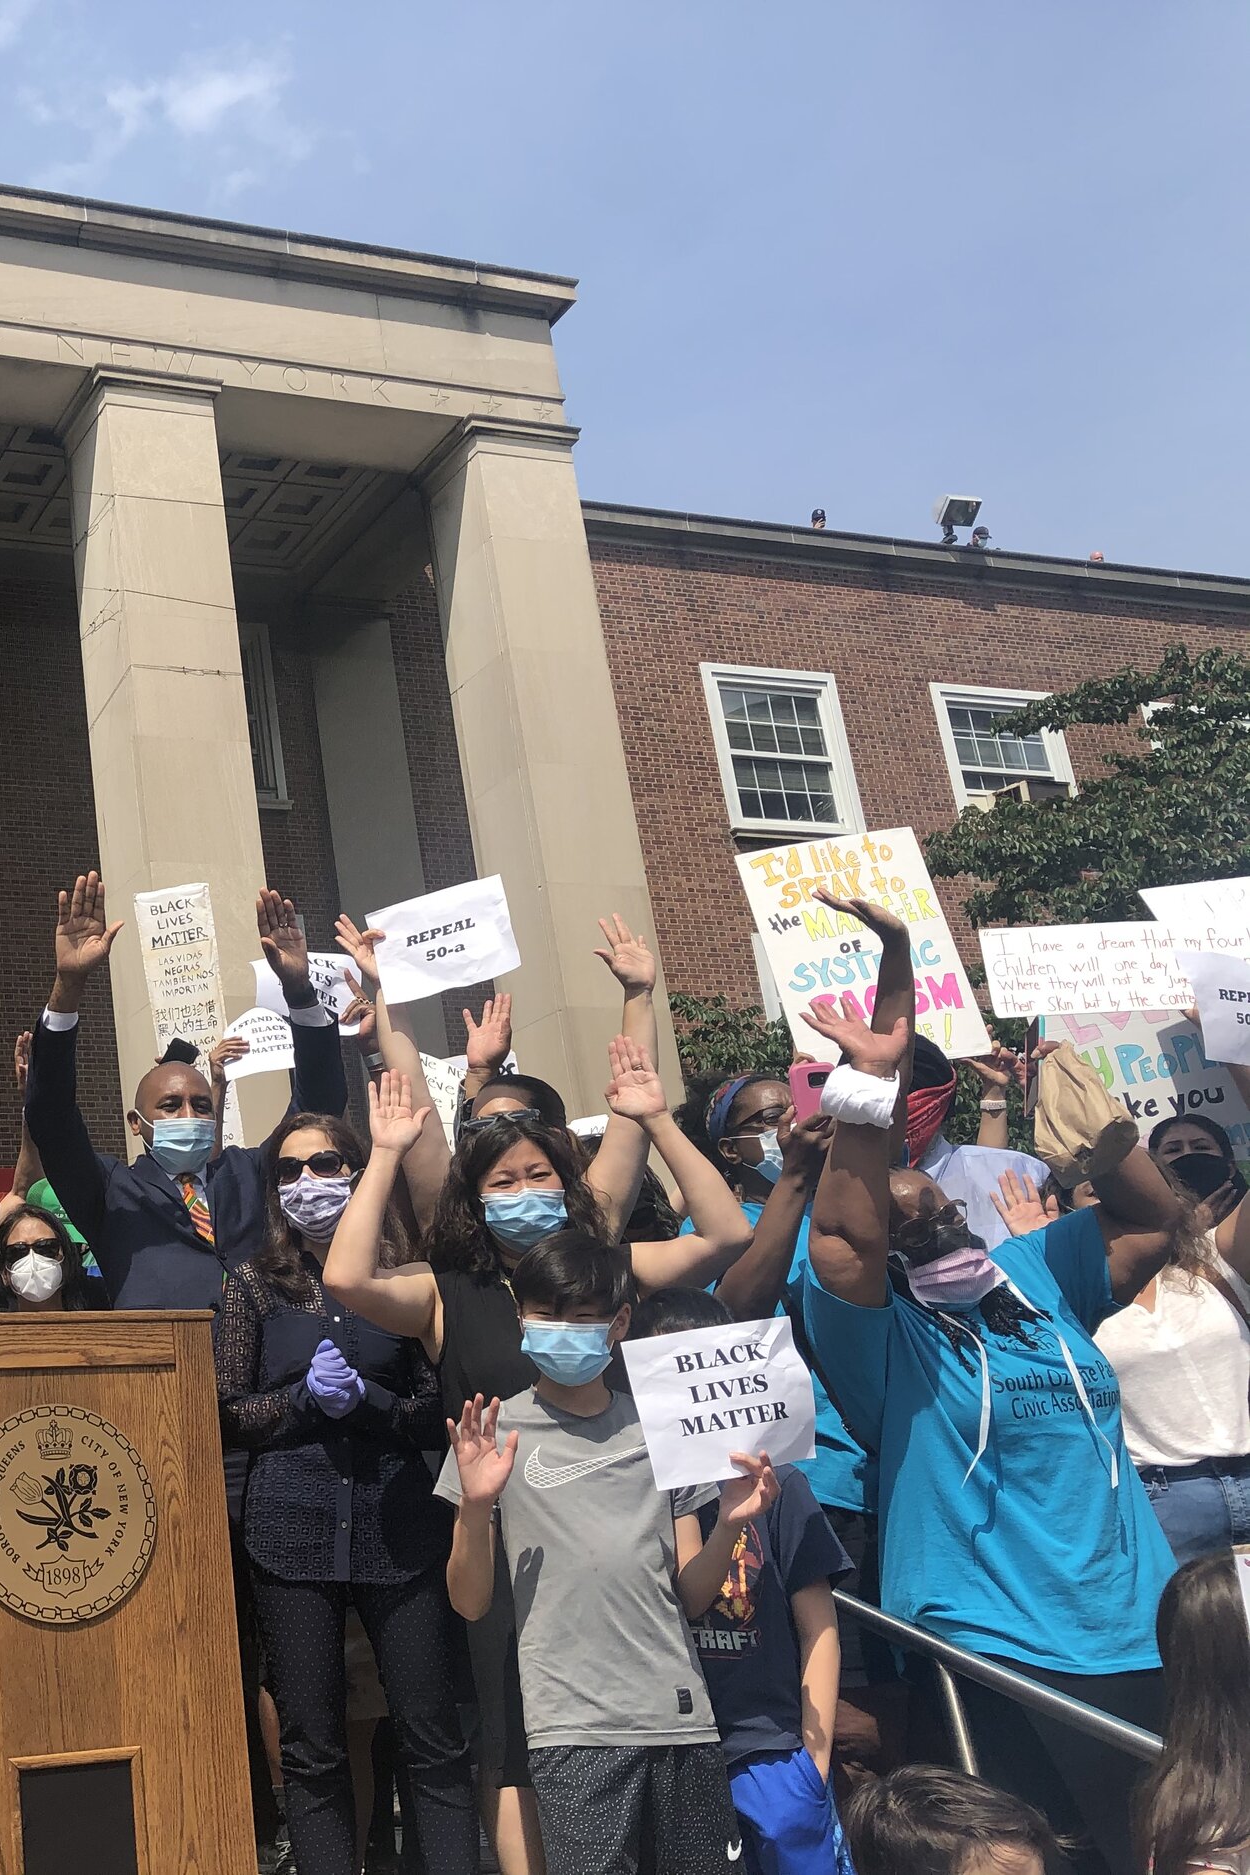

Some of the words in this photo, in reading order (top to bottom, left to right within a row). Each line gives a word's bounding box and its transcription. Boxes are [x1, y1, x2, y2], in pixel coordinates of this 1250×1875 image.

[55, 336, 198, 377] NEW
[236, 358, 392, 403] YORK
[749, 846, 804, 888] I'd
[809, 841, 862, 874] like
[861, 834, 894, 864] to
[870, 866, 906, 895] to
[150, 897, 196, 916] BLACK
[157, 912, 194, 930] LIVES
[406, 918, 476, 948] REPEAL
[767, 912, 802, 935] the
[151, 926, 209, 949] MATTER
[840, 939, 863, 955] OF
[1028, 931, 1065, 954] have
[1076, 942, 1086, 951] a
[1096, 931, 1136, 950] dream
[1140, 928, 1177, 949] that
[1184, 937, 1202, 951] my
[1206, 927, 1245, 949] four
[158, 955, 174, 966] LAS
[176, 949, 203, 963] VIDAS
[425, 942, 466, 962] 50-a
[164, 961, 201, 977] NEGRAS
[196, 968, 216, 980] NOS
[788, 939, 942, 993] SYSTIC
[1069, 956, 1101, 973] will
[1114, 960, 1139, 972] one
[1150, 952, 1168, 977] day
[161, 982, 210, 998] IMPORTAN
[1048, 975, 1079, 995] they
[1081, 973, 1106, 987] will
[1112, 972, 1134, 986] not
[1141, 970, 1156, 985] be
[1082, 993, 1102, 1010] but
[1108, 990, 1121, 1012] by
[1128, 989, 1154, 1008] the
[1218, 988, 1250, 1004] REP
[238, 1015, 273, 1029] STAND
[251, 1024, 287, 1035] BLACK
[256, 1034, 288, 1044] LIVES
[1114, 1032, 1222, 1086] PEOPL
[1167, 1087, 1225, 1117] you
[672, 1342, 769, 1374] BLACK
[687, 1373, 770, 1404] LIVES
[990, 1367, 1044, 1394] South
[1046, 1366, 1099, 1388] Ozne
[1011, 1394, 1050, 1420] Civic
[678, 1401, 790, 1438] MATTER
[80, 1435, 110, 1459] CITY
[107, 1460, 123, 1479] OF
[116, 1483, 129, 1515] NEW
[103, 1521, 128, 1558] YORK
[45, 1566, 82, 1587] 1898
